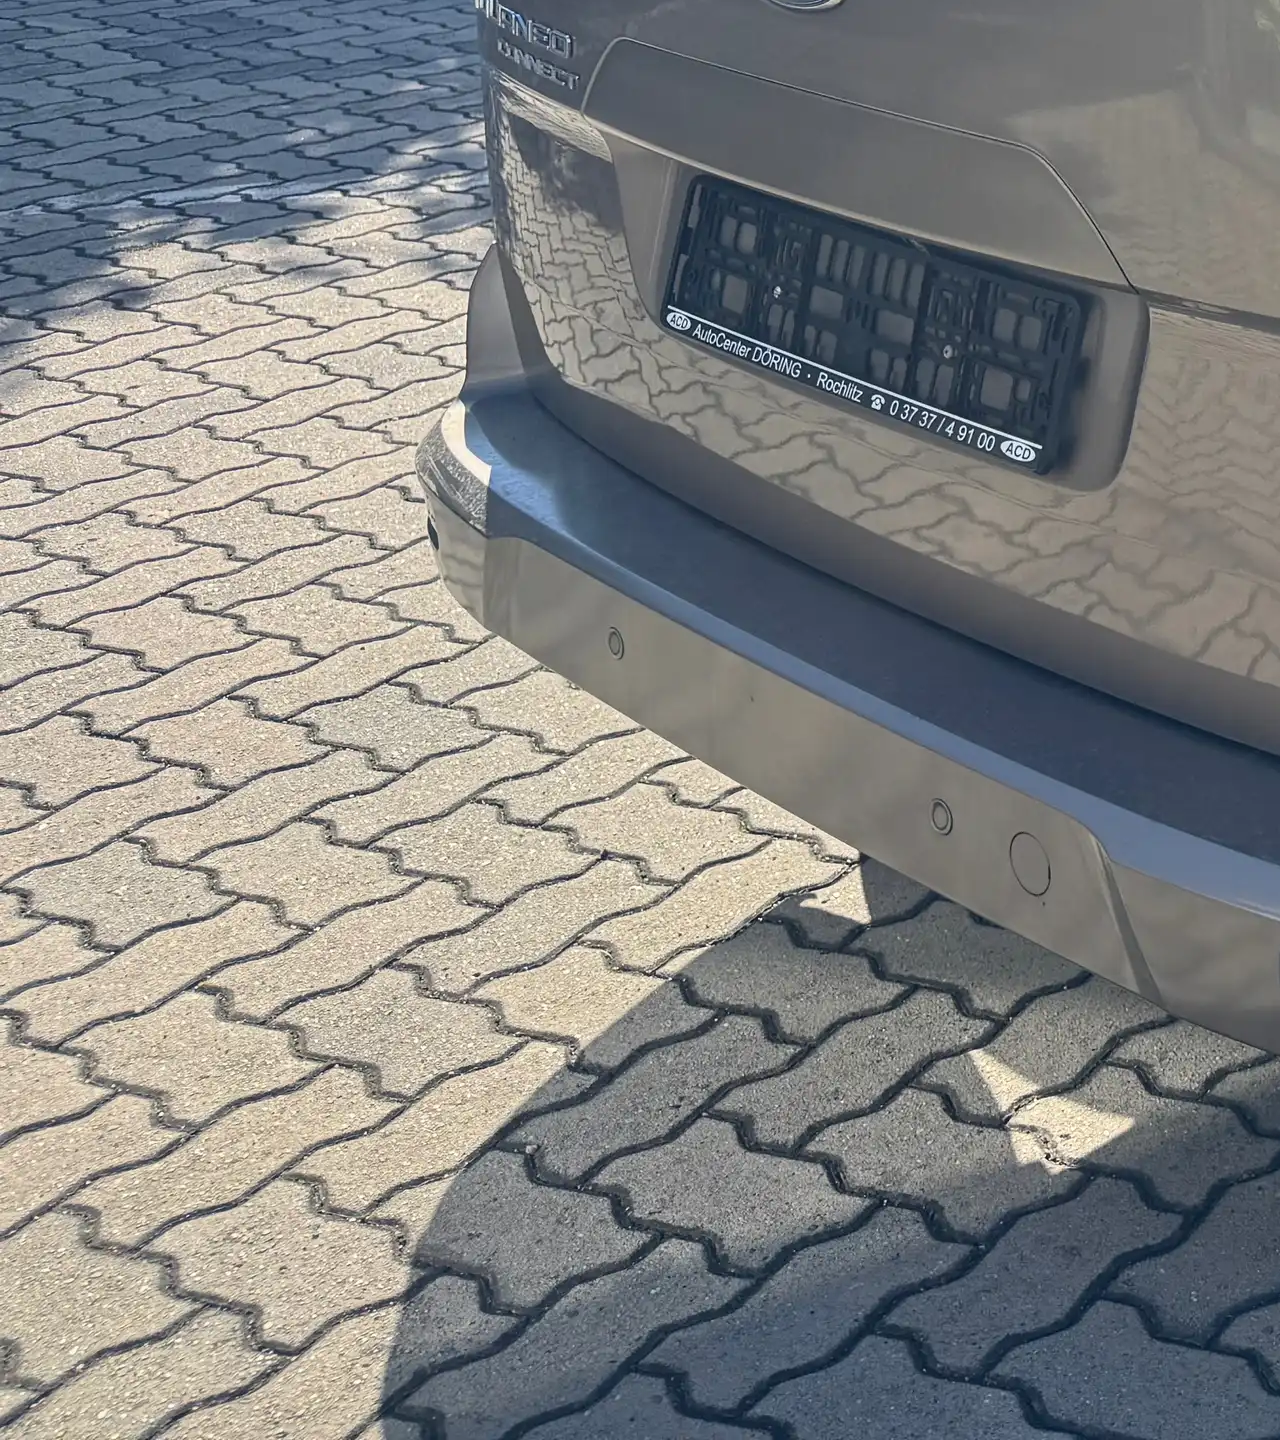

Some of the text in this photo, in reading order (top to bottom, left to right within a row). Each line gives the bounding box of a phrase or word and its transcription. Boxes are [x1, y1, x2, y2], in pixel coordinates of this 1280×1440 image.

[669, 314, 689, 329] ACD
[692, 324, 751, 357] AutoCenter
[752, 346, 802, 378] DÖRING
[817, 372, 863, 403] Rochlitz
[890, 400, 899, 416] 0
[901, 404, 918, 422] 37
[919, 410, 936, 429] 37
[945, 421, 954, 436] 4
[957, 425, 974, 444] 91
[977, 432, 996, 451] 00
[1004, 442, 1032, 460] ACD
